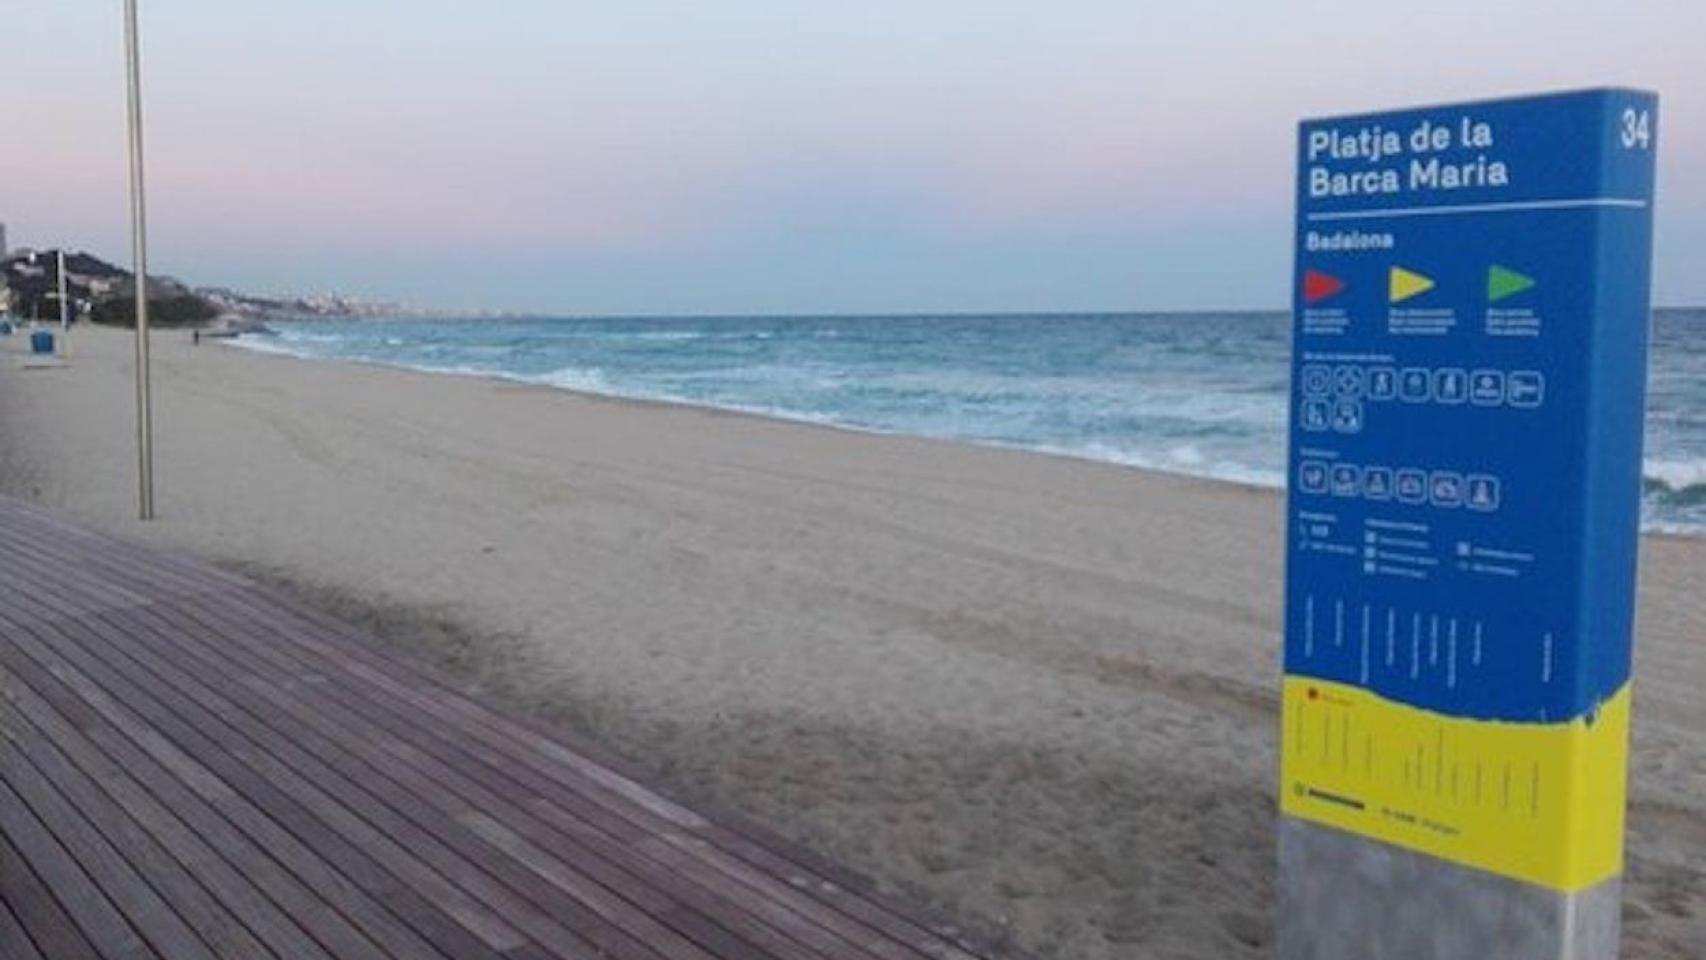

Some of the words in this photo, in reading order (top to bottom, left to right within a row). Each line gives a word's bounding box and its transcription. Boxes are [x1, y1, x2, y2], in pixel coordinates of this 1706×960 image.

[1308, 126, 1400, 162] Platja
[1410, 121, 1451, 152] de
[1461, 117, 1493, 147] la
[1622, 107, 1650, 149] 34
[1309, 168, 1399, 197] Barca
[1410, 156, 1508, 190] Maria
[1307, 231, 1394, 251] Badalona
